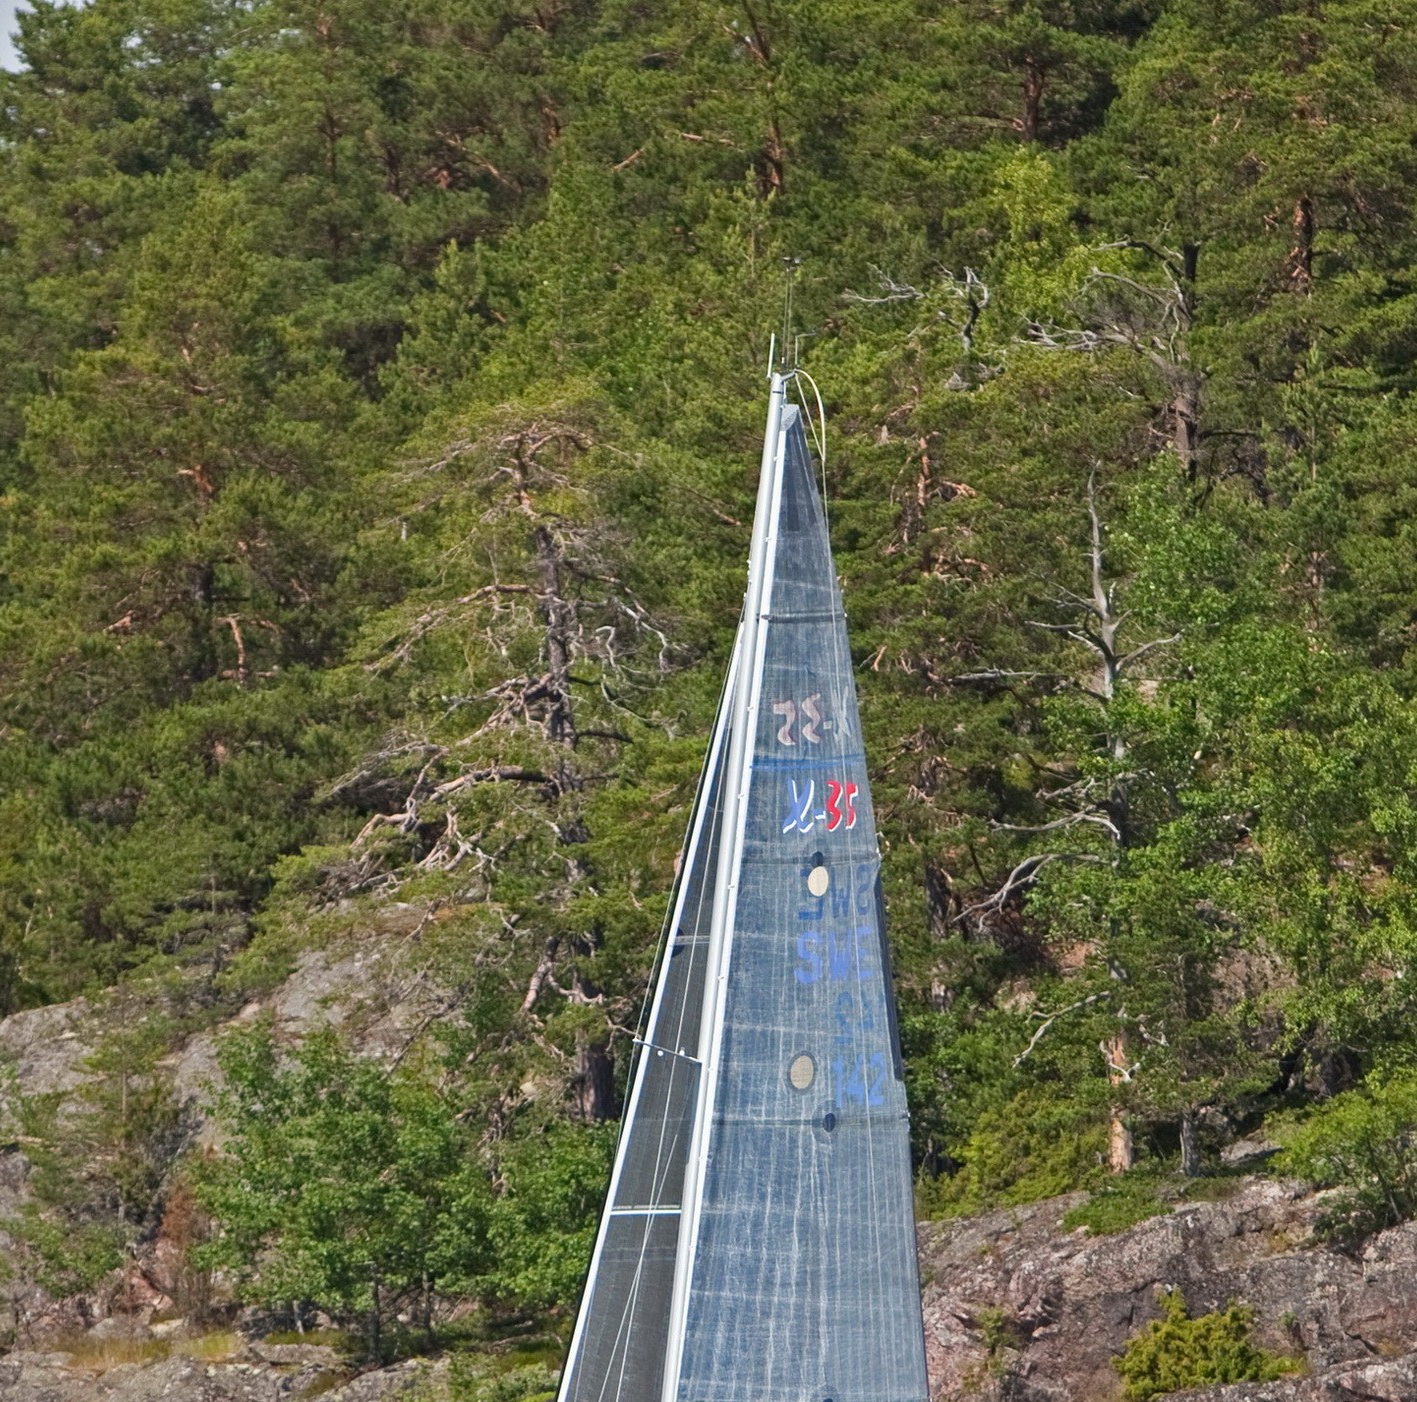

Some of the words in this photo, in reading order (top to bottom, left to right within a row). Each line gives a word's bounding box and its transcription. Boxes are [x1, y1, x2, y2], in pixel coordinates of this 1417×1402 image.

[783, 778, 859, 835] X-35
[794, 926, 873, 985] SWE
[832, 1053, 885, 1109] 142
